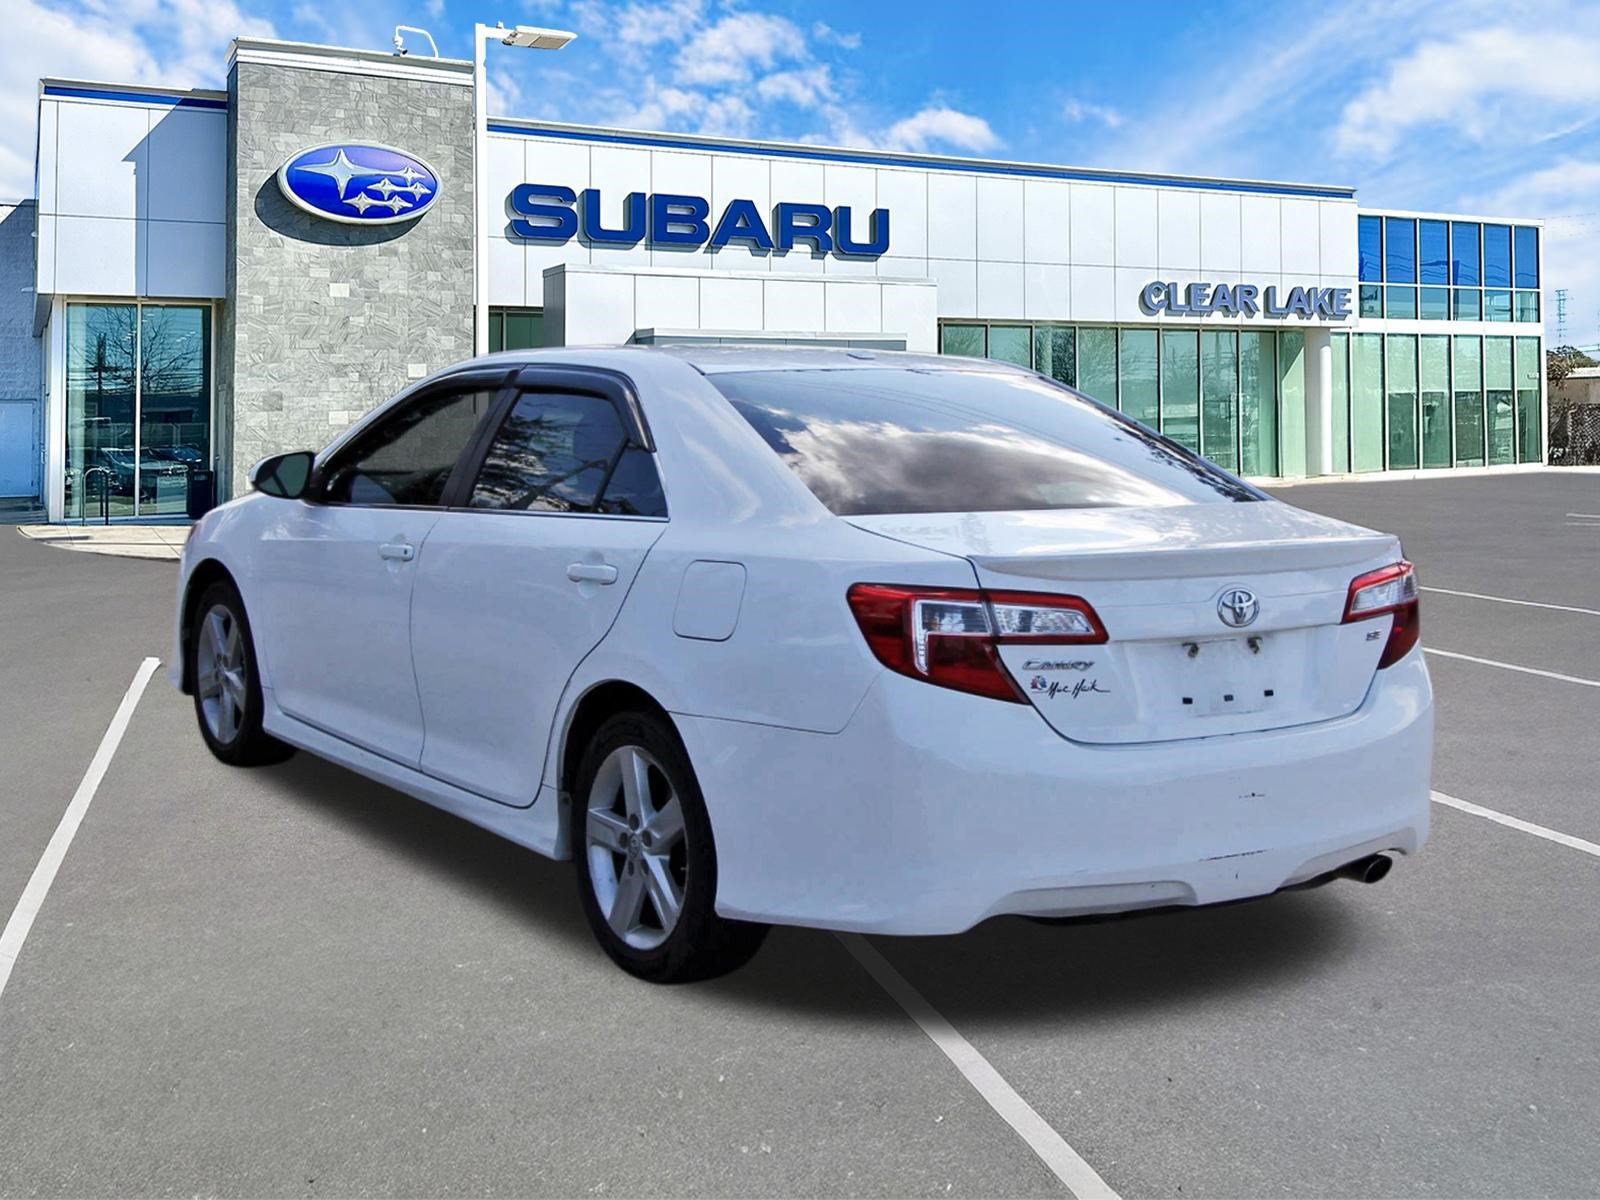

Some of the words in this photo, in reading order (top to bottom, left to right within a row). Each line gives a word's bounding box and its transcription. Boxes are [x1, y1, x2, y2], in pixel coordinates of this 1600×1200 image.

[506, 183, 890, 260] SUBARU
[1140, 281, 1260, 317] CLEAR
[1264, 286, 1353, 319] LAKE
